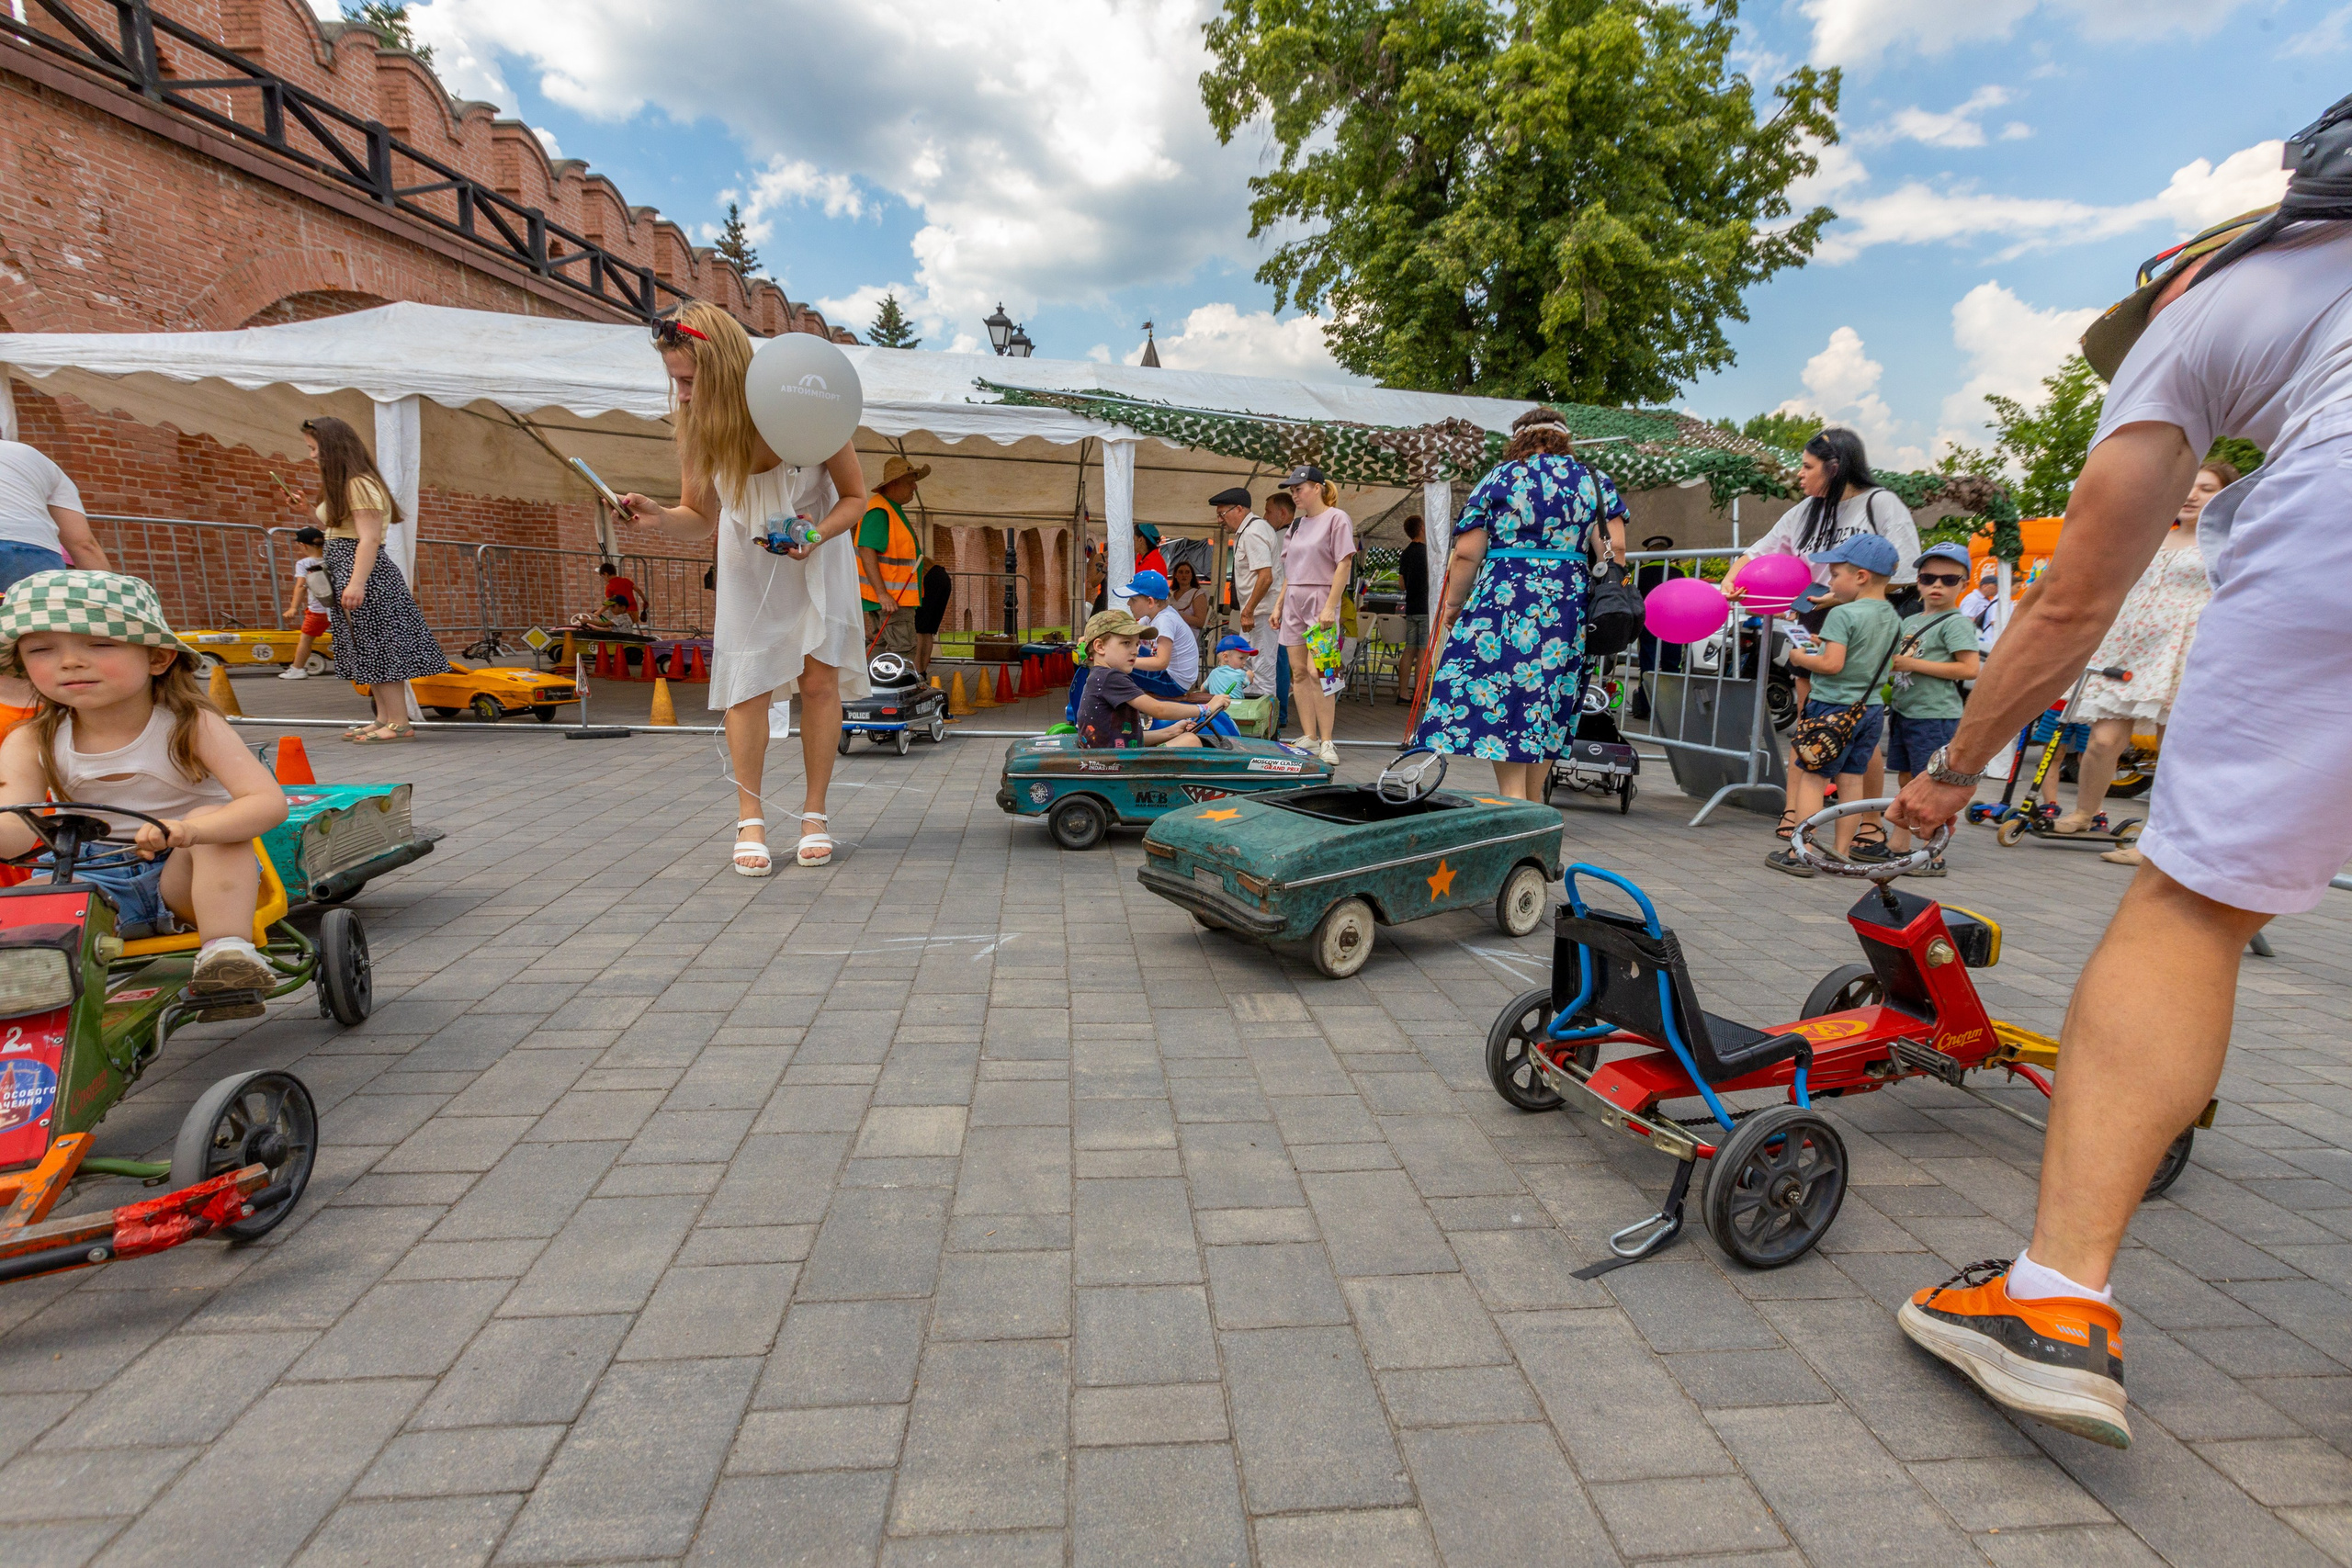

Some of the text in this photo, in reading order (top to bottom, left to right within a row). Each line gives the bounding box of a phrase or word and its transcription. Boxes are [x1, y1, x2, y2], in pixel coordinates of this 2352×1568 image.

[781, 384, 842, 401] АВТОИМПОРТ
[848, 711, 870, 719] POLICE
[1818, 732, 1838, 756] RELAX
[2033, 729, 2063, 784] SCOOTER
[1936, 1027, 1984, 1052] Спорт
[3, 1086, 56, 1100] ОСОБОГО
[71, 1069, 108, 1117] Спорт
